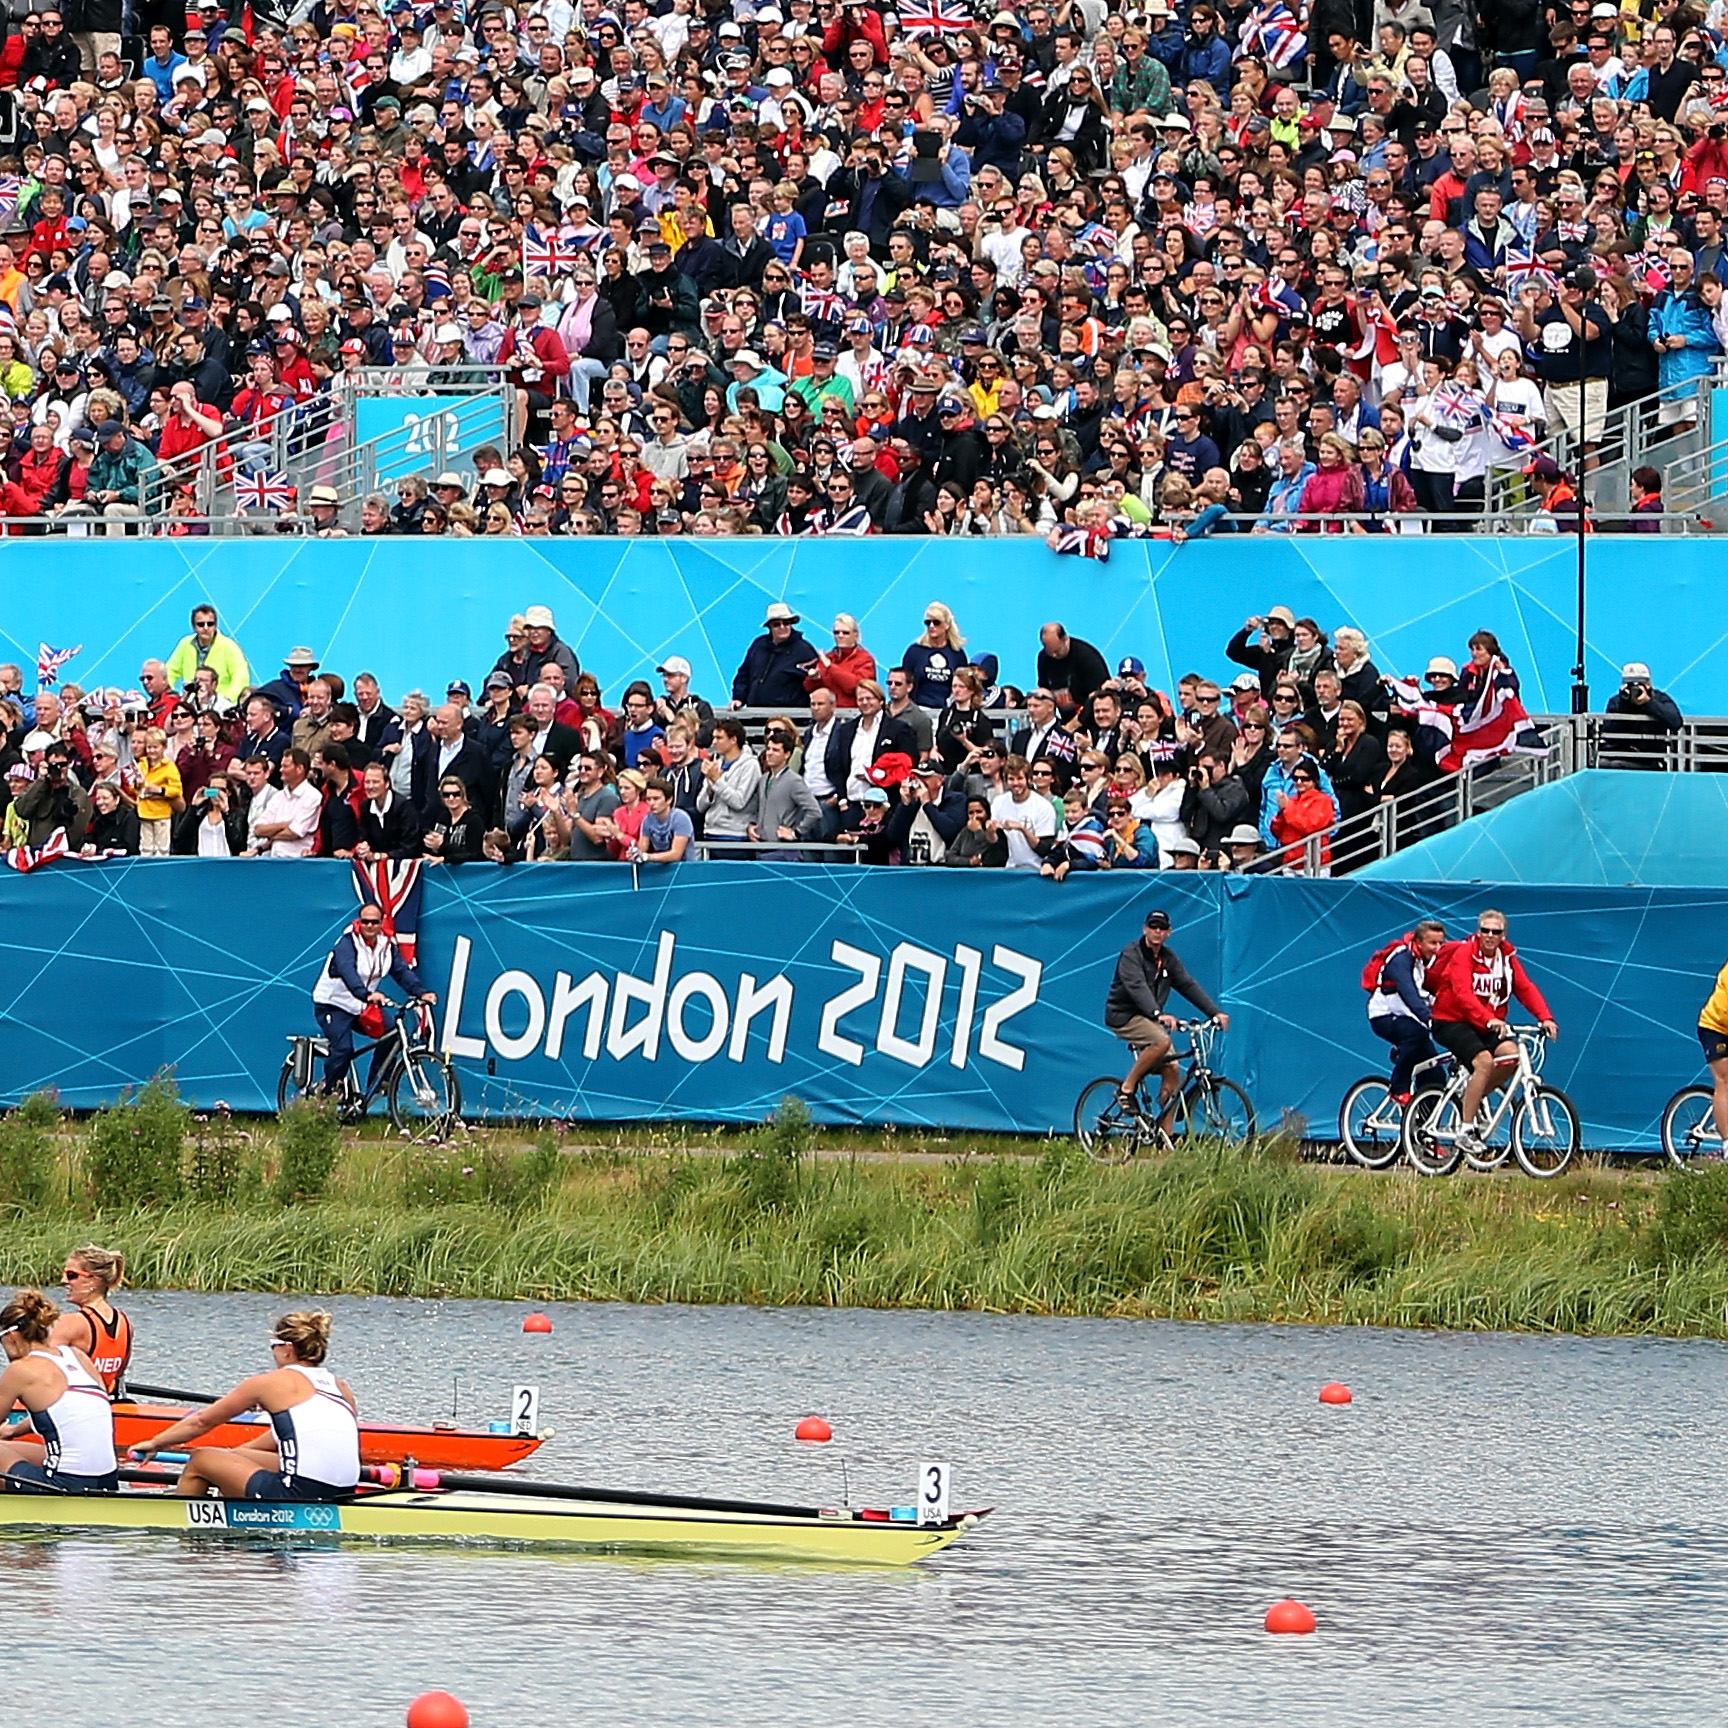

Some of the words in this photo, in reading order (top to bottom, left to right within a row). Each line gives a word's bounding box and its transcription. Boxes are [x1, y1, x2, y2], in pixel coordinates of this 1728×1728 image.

[443, 930, 794, 1063] London
[817, 939, 1043, 1072] 2012
[94, 1357, 122, 1373] NED
[518, 1389, 533, 1420] 2
[925, 1466, 942, 1503] 3
[189, 1503, 225, 1524] USA
[233, 1508, 270, 1523] London
[271, 1509, 295, 1522] 2012
[923, 1507, 942, 1519] USA
